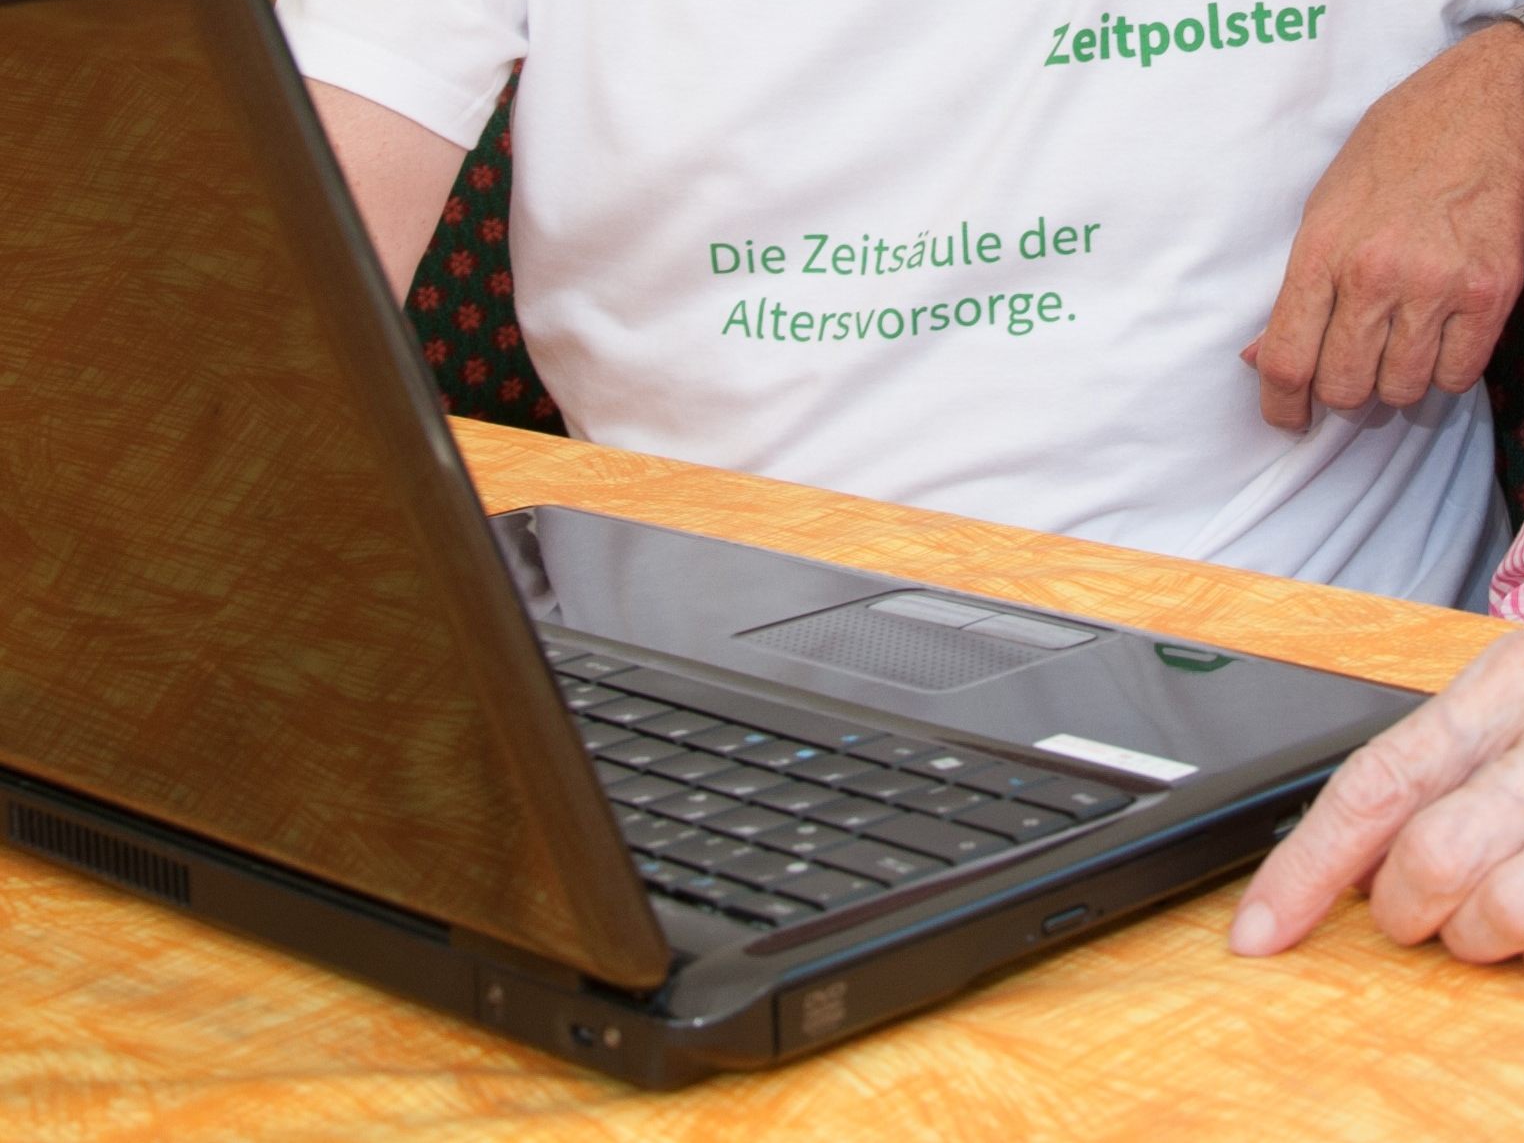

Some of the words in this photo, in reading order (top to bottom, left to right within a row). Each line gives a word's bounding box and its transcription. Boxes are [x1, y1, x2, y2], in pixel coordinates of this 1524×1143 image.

[1044, 1, 1327, 68] Zeitpolster
[709, 239, 786, 275] Die
[801, 221, 1003, 276] Zeitsäule
[1018, 216, 1101, 259] der
[721, 291, 1077, 343] Altersvorsorge.
